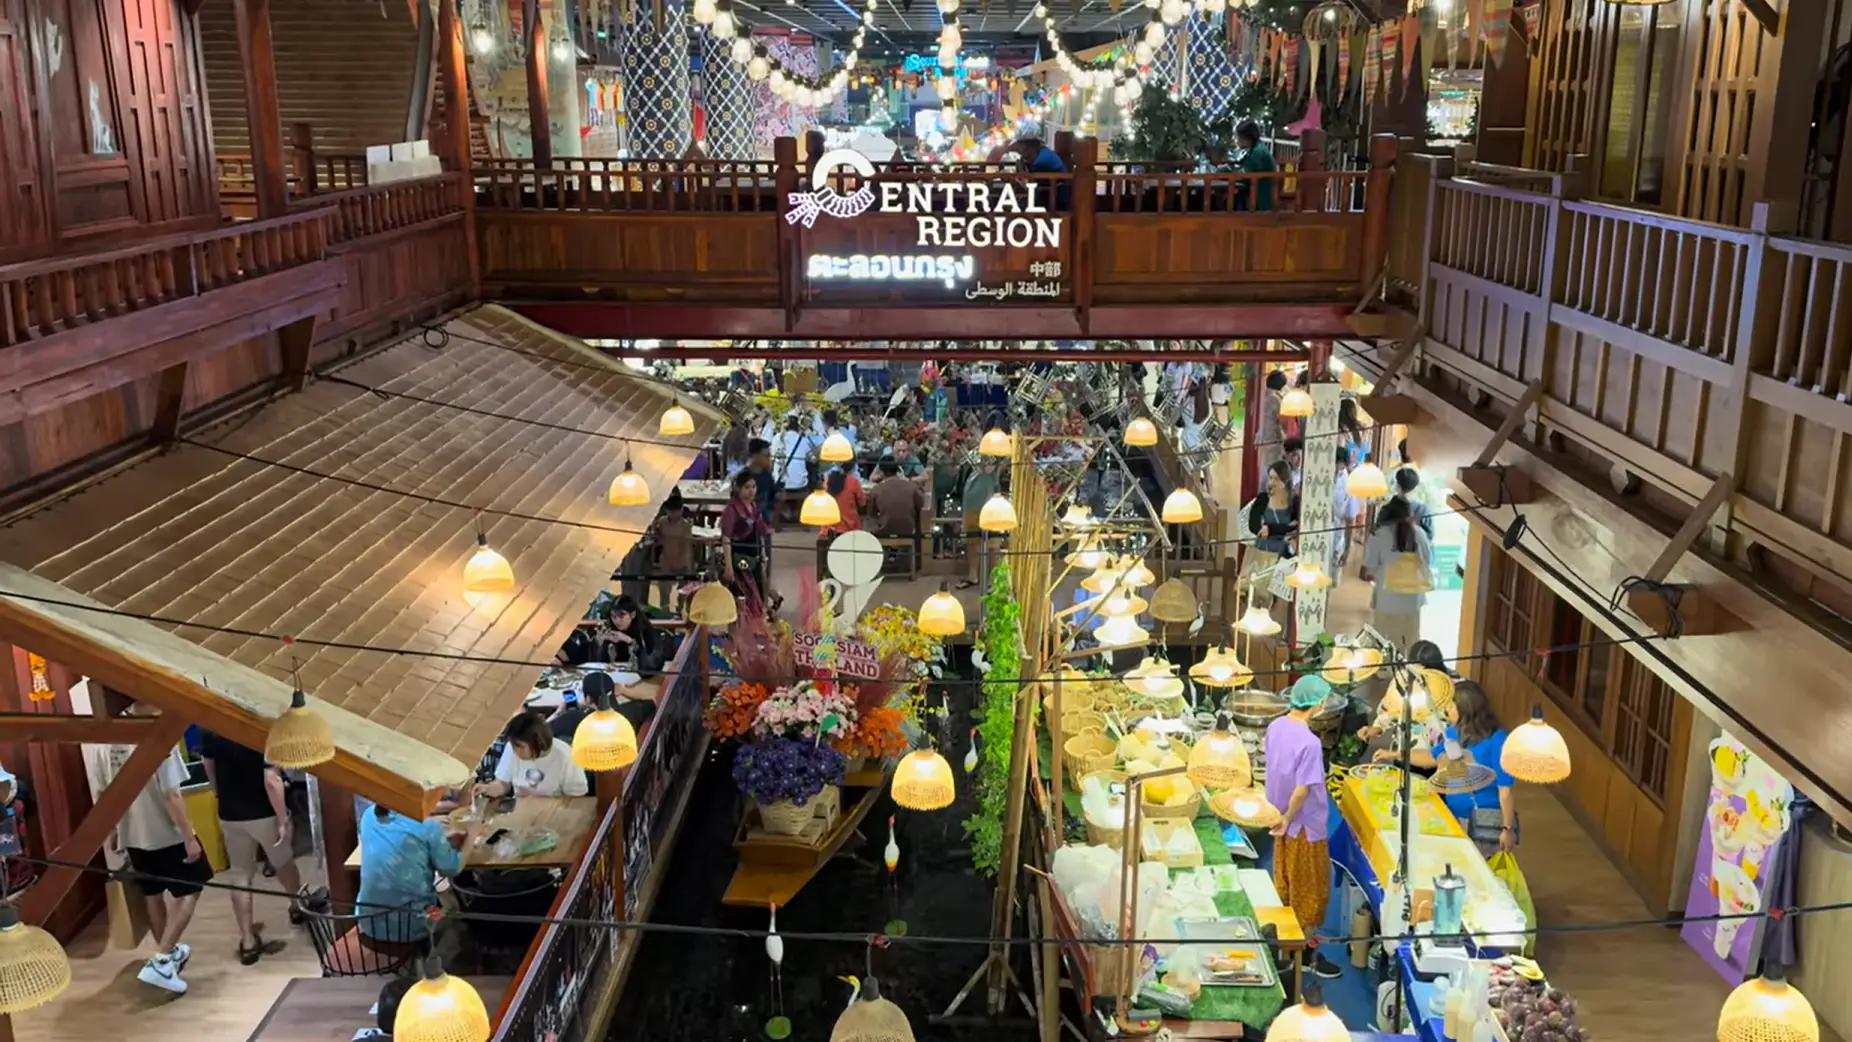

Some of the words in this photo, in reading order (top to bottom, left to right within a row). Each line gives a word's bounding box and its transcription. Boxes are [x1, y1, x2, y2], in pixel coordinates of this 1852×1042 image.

[812, 149, 1046, 217] CENTRAL
[916, 217, 1063, 247] REGION
[1029, 260, 1061, 277] 中部
[965, 280, 1013, 300] الوسطى
[1017, 280, 1060, 297] المنطقة
[794, 632, 876, 660] SOSIAM
